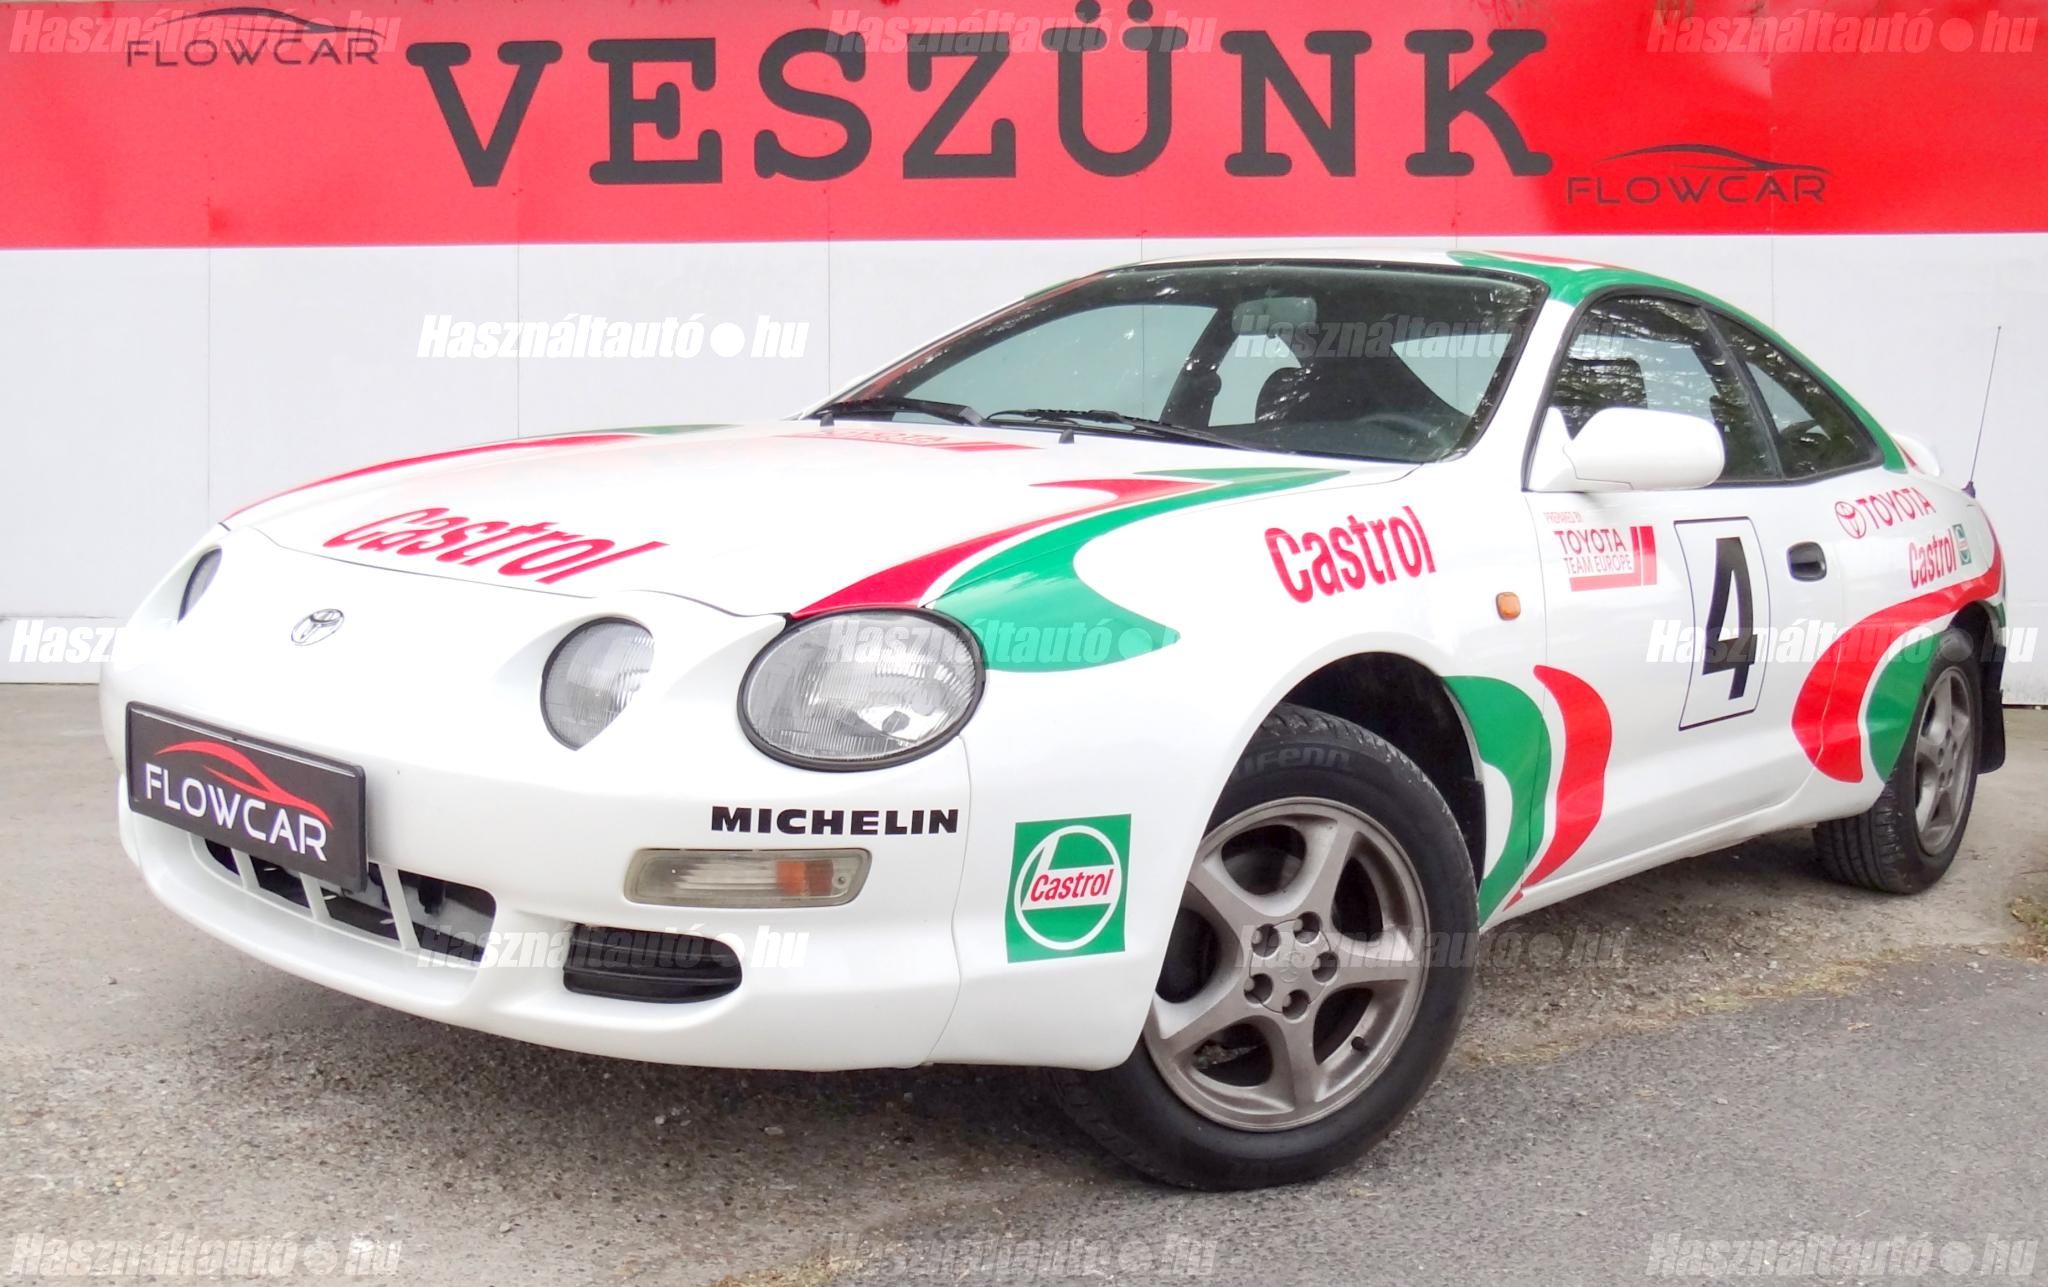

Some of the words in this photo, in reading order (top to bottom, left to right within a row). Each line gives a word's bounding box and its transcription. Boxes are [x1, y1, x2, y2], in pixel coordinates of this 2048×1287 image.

[127, 38, 379, 67] FLOWCAR
[406, 0, 1553, 186] VESZÜNK
[1567, 176, 1826, 204] FLOWCAR
[1856, 487, 1937, 530] TOYOTA
[324, 508, 665, 584] Castrol
[1265, 506, 1435, 603] Castrol
[1553, 528, 1627, 555] TOYOTA
[1909, 528, 1958, 589] Castrol
[1563, 556, 1593, 574] TEAM
[1593, 554, 1633, 572] EUROPE
[1703, 537, 1757, 700] 4
[145, 763, 327, 862] FLOWCAR
[712, 806, 958, 835] MICHELIN
[1030, 868, 1115, 902] Castrol
